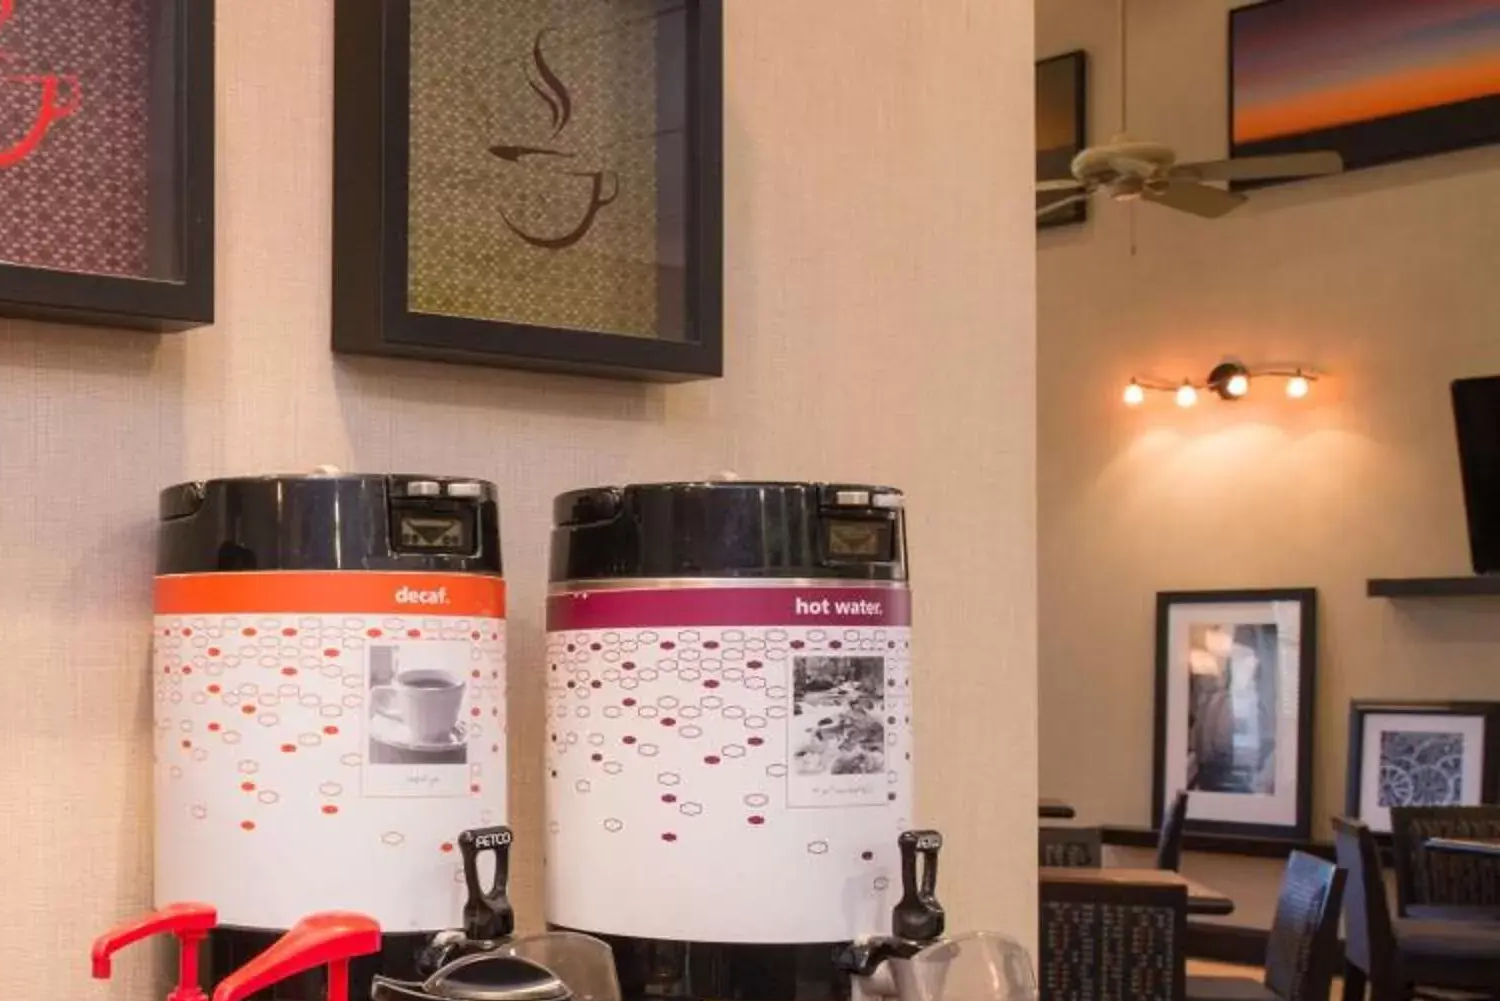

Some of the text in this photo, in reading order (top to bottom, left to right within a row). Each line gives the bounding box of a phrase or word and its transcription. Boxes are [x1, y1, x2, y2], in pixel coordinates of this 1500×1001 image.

[395, 585, 451, 605] decaf.
[795, 597, 883, 616] hot water.
